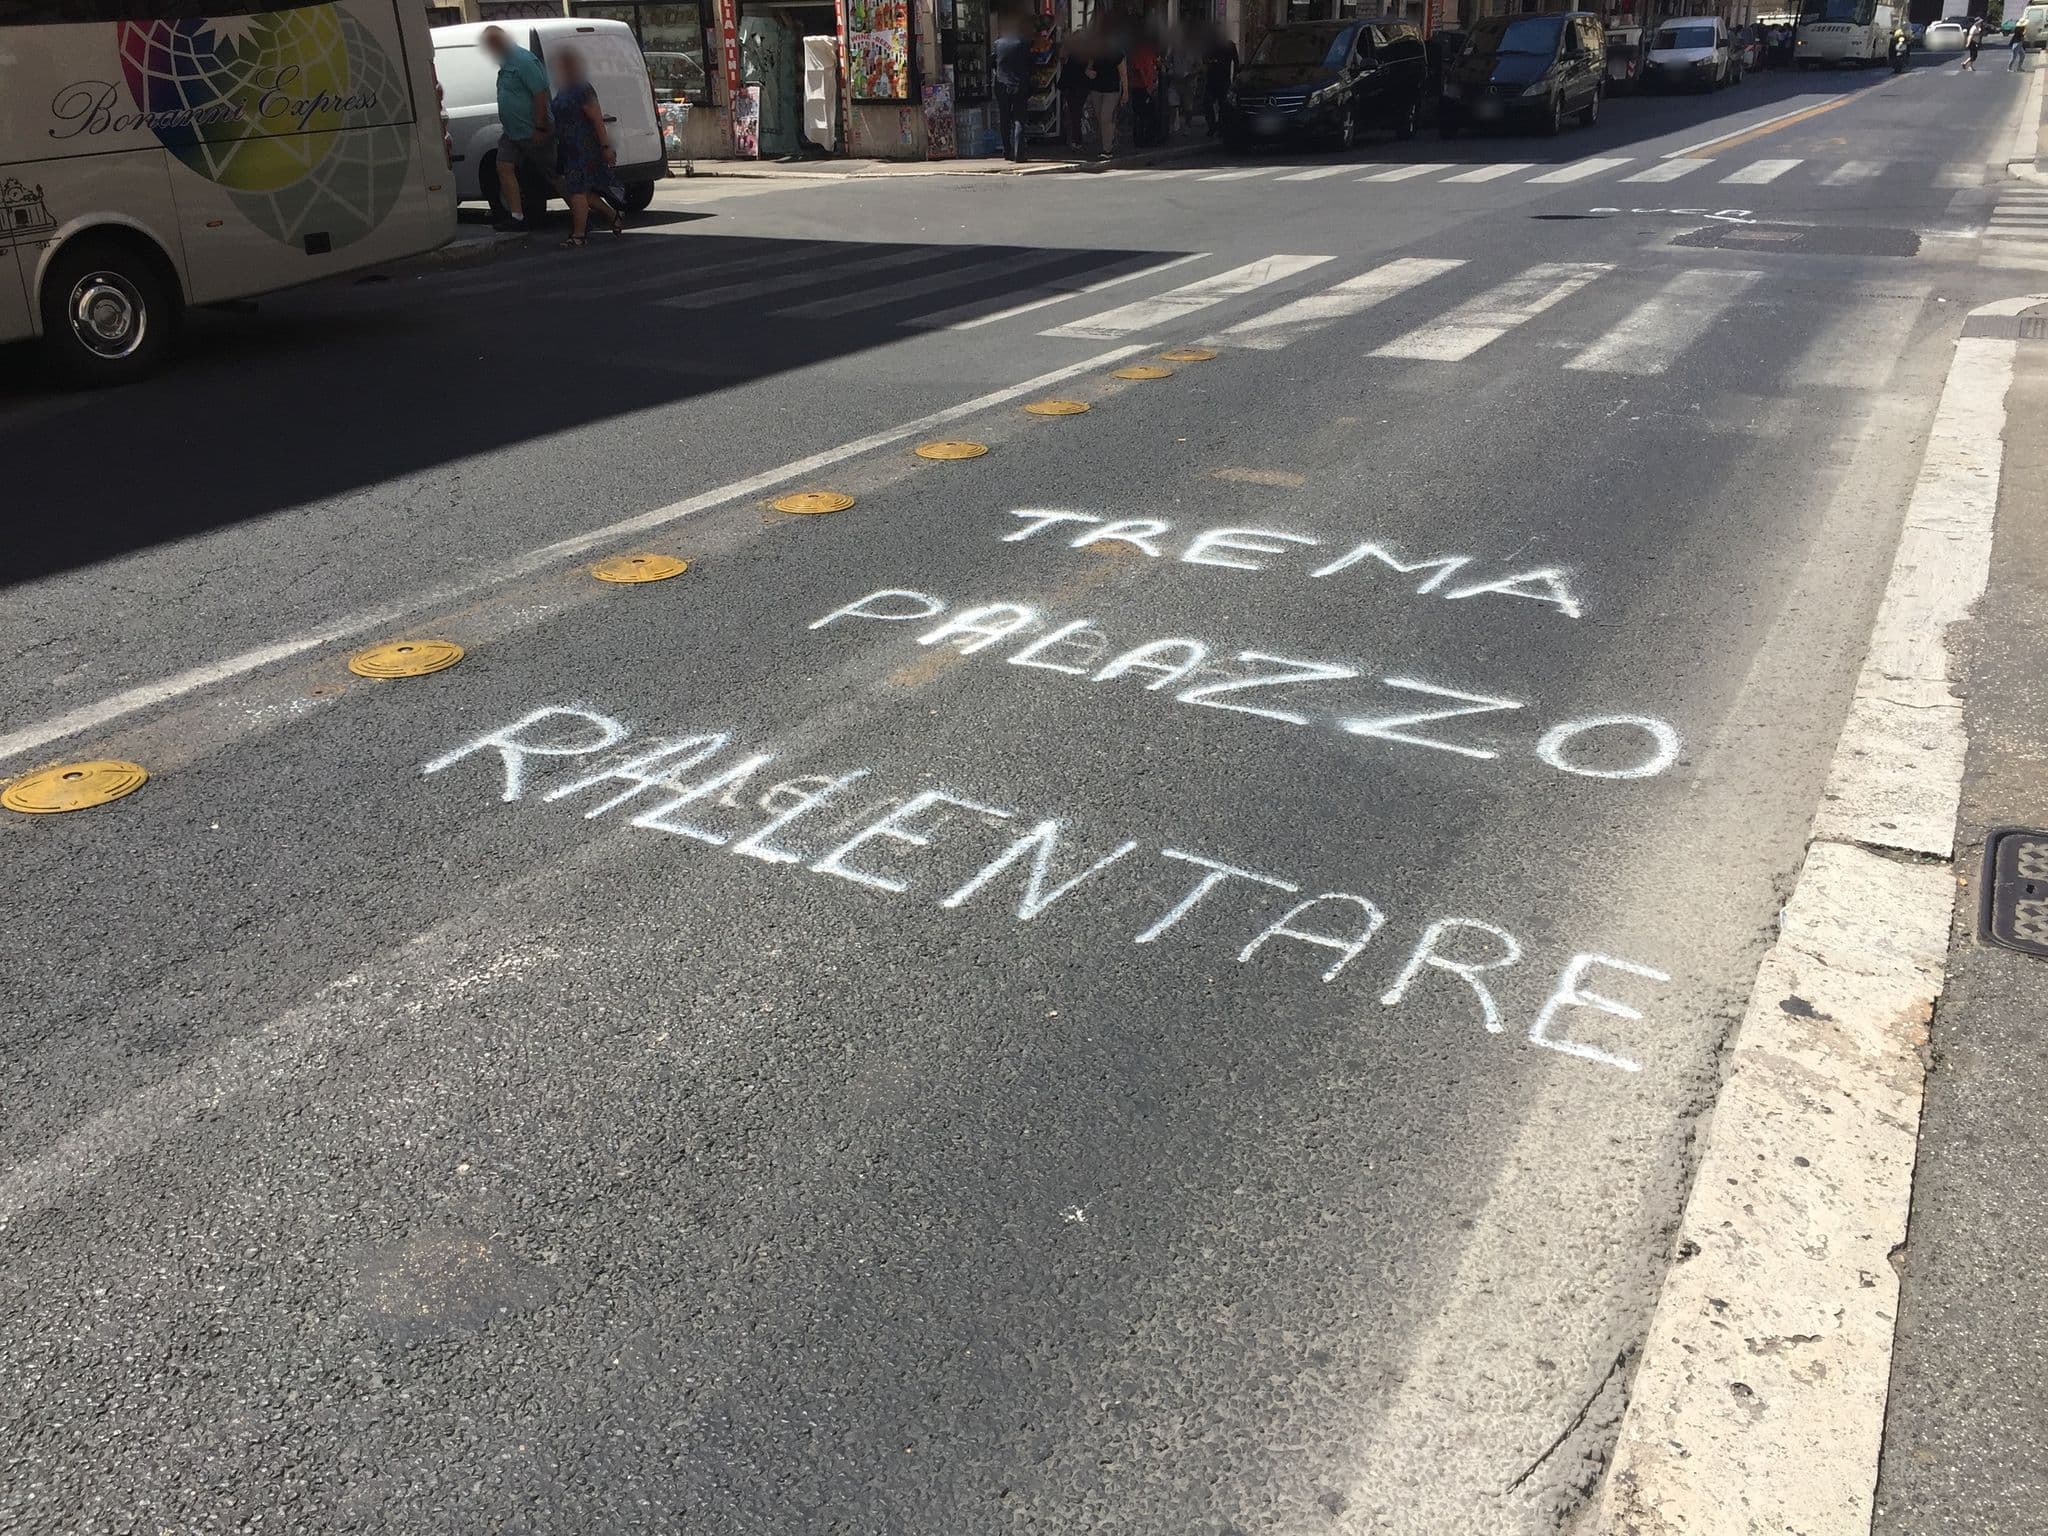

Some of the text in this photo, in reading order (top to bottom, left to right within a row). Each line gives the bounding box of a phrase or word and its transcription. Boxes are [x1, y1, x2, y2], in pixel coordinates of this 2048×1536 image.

[48, 64, 378, 139] Bonanni Express
[725, 38, 737, 80] MINI
[1000, 508, 1584, 619] TREMA
[809, 588, 1680, 779] PALAZZO
[423, 703, 1671, 1073] RALLENTARE
